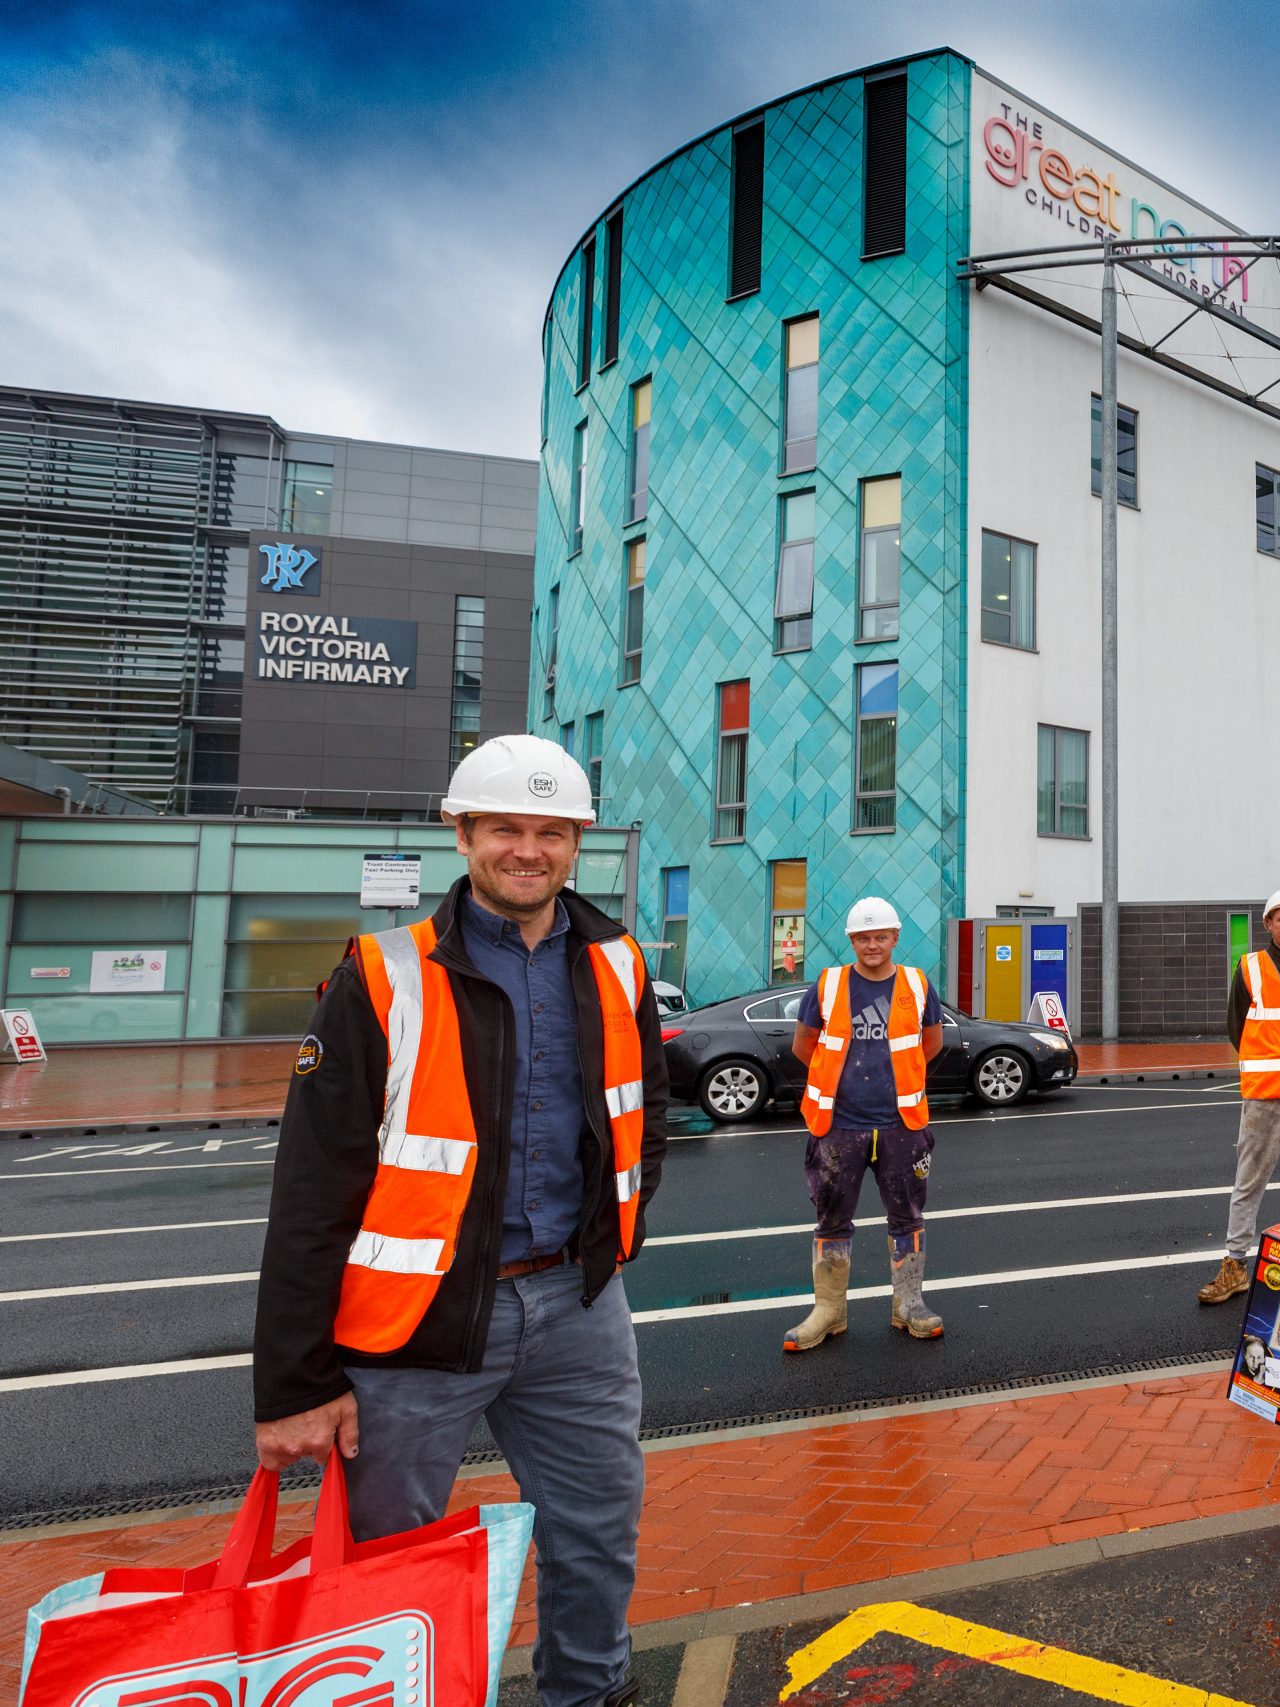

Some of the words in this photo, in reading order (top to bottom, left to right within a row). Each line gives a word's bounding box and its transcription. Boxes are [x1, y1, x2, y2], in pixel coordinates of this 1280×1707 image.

[1001, 103, 1043, 140] THE
[984, 117, 1121, 232] great
[261, 611, 357, 637] ROYAL
[260, 635, 390, 662] VICTORIA
[258, 658, 409, 686] INFIRMARY
[298, 1057, 315, 1065] SAFE
